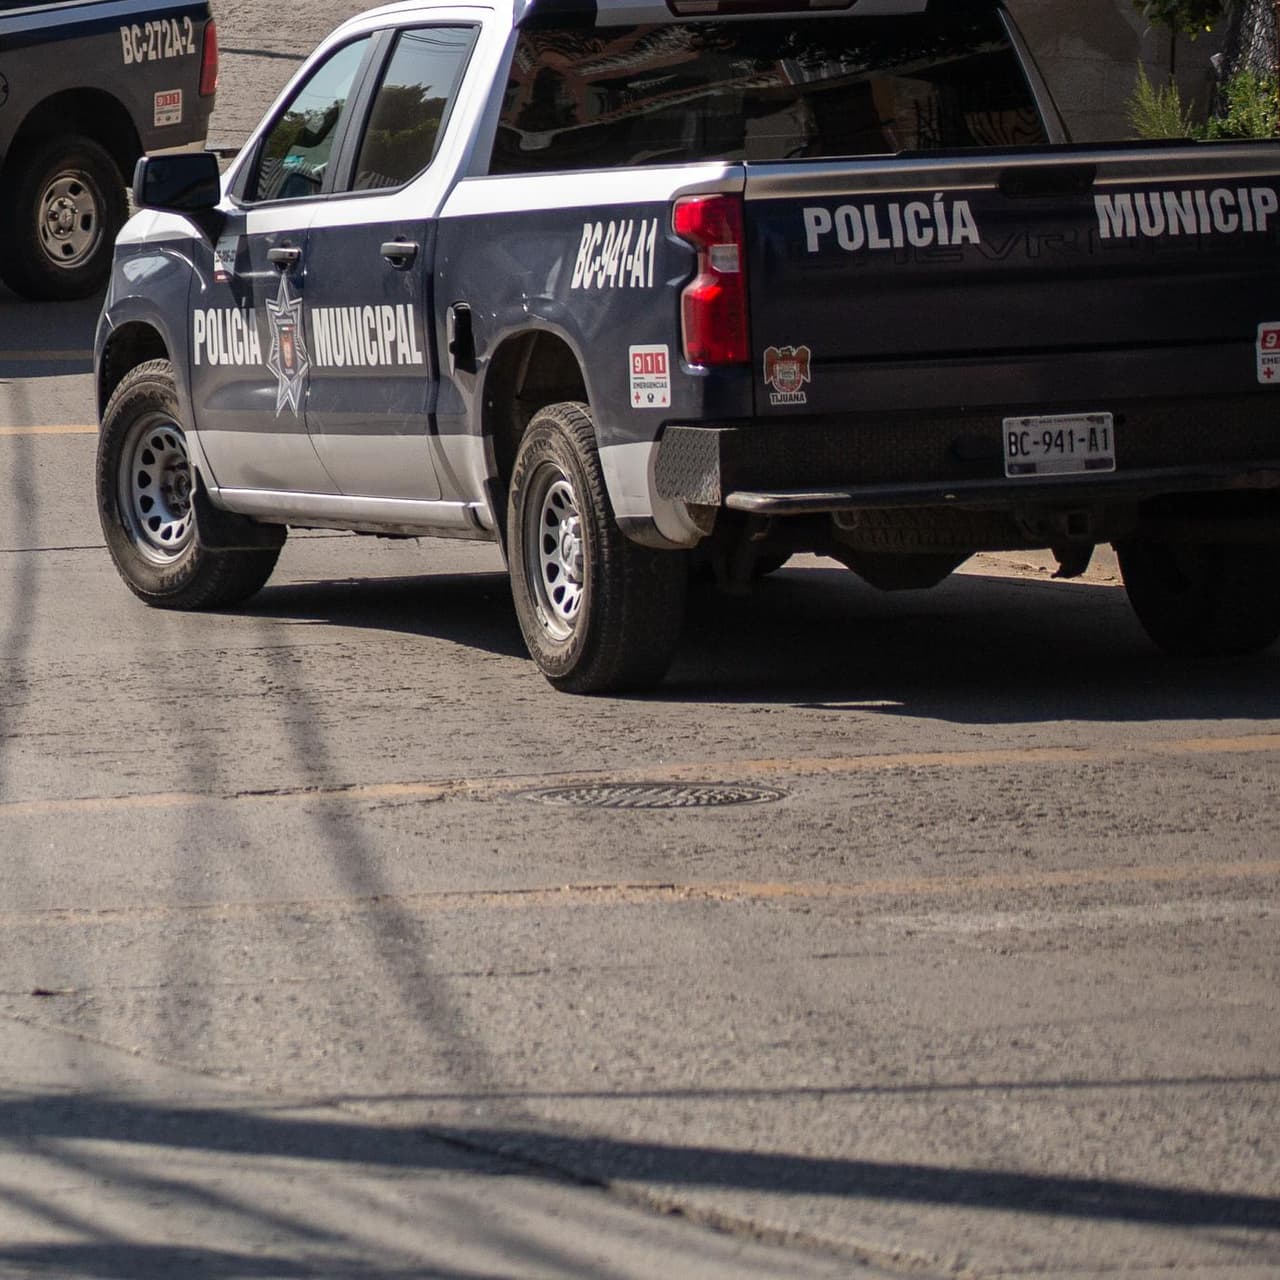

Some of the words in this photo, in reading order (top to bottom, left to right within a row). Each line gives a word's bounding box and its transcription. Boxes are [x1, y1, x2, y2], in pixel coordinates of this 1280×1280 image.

[120, 16, 195, 64] BC-272A-2
[803, 192, 980, 253] POLICÍA
[1094, 187, 1279, 238] MUNICIP
[571, 218, 658, 289] BC-941-A1
[194, 297, 263, 366] POLICÍA
[311, 304, 424, 367] MUNICIPAL
[633, 354, 666, 373] 911
[1008, 427, 1109, 457] BC-941-A1
